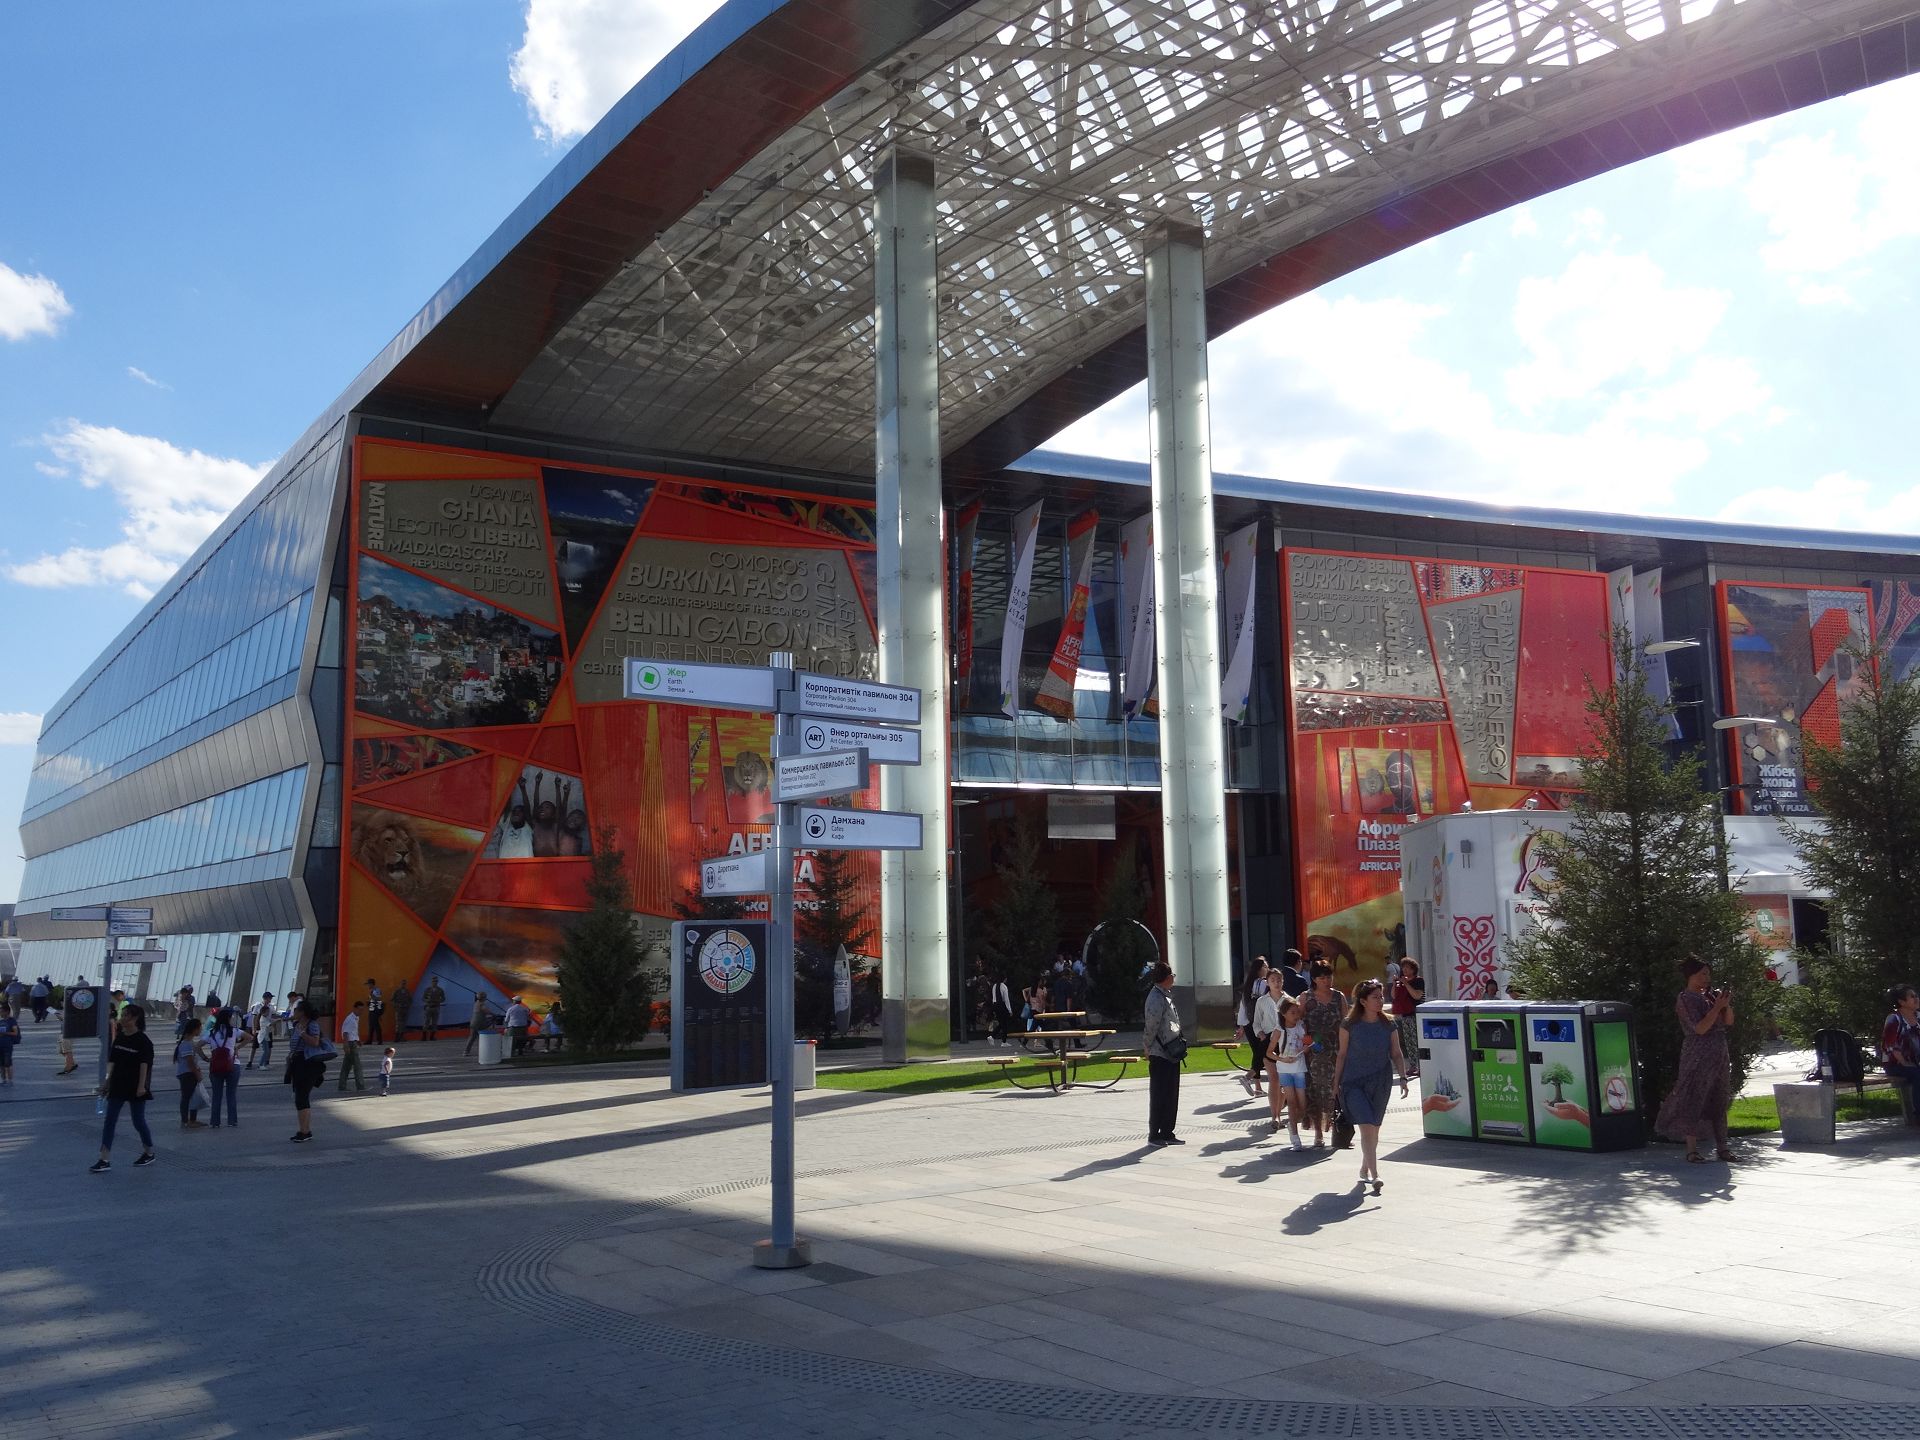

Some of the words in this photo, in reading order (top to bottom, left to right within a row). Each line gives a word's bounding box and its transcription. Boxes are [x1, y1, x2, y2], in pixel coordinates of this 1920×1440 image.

[469, 484, 533, 504] UGANDA
[368, 482, 385, 550] NATURE
[439, 498, 537, 529] GHANA
[388, 512, 467, 538] LESOTHO
[470, 527, 542, 550] LIBERIA
[388, 539, 508, 563] MADAGASCAR
[411, 558, 463, 571] REPUBLIC
[464, 562, 480, 572] OF
[480, 564, 501, 575] THE
[502, 566, 545, 578] CONGO
[707, 551, 808, 577] COMOROS
[1292, 554, 1366, 573] COMOROS
[1368, 560, 1407, 576] BENIN
[472, 576, 546, 596] DJIBOUTI
[626, 562, 737, 597] BURKINA
[742, 575, 809, 602] FASO
[1293, 571, 1362, 591] BURKINA
[1364, 576, 1412, 595] FASO
[616, 591, 685, 608] DEMOCRATIC
[687, 597, 736, 613] REPUBLIC
[737, 602, 750, 613] OF
[751, 603, 770, 615] THE
[771, 606, 809, 618] CONGO
[816, 562, 837, 651] GUINEA
[609, 606, 692, 638] BENIN
[697, 615, 812, 650] GABON
[839, 598, 856, 653] KENYA
[1500, 600, 1516, 665] GHANA
[1383, 601, 1400, 677] NATURE
[1481, 603, 1502, 687] FUTURE
[602, 637, 680, 660] FUTURE
[684, 643, 761, 666] ENERGY
[667, 667, 687, 678] Жер
[805, 682, 861, 697] Корпоративтік
[862, 689, 898, 701] павильон
[899, 693, 913, 702] 304
[808, 734, 822, 742] ART
[830, 728, 850, 738] Өнер
[889, 733, 903, 742] 305
[1486, 693, 1508, 781] ENERGY
[819, 760, 844, 770] павильон
[845, 756, 856, 765] 202
[1759, 764, 1797, 778] Жібек
[1786, 804, 1810, 813] PLAZA
[1358, 836, 1400, 851] Плаза
[1360, 861, 1394, 871] AFRICA
[1480, 1073, 1504, 1082] EXPO
[1481, 1083, 1503, 1092] 2017
[1482, 1093, 1519, 1103] ASTANA
